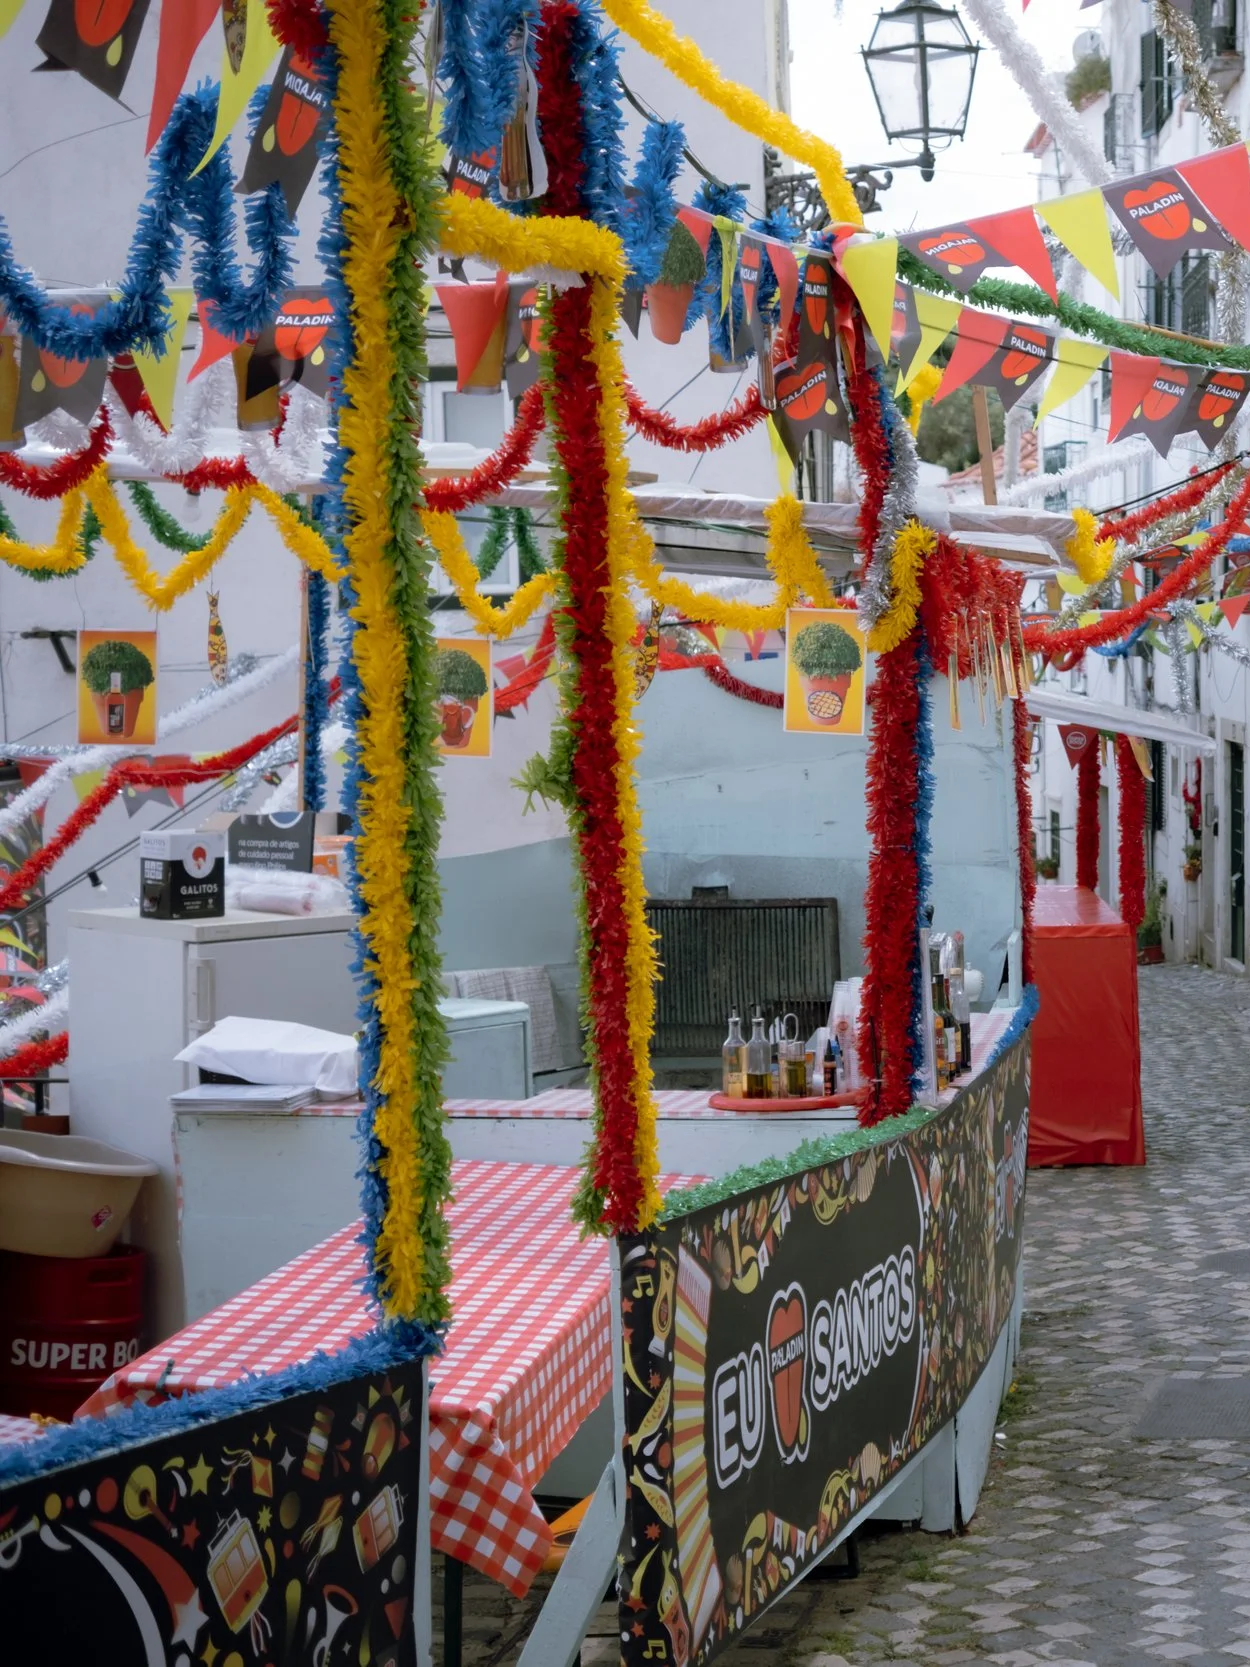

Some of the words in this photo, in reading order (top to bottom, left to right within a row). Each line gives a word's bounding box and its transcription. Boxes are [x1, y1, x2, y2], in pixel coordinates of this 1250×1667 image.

[456, 159, 490, 184] PALADIN
[1129, 193, 1184, 220] PALADIN
[804, 283, 828, 297] PALADIN
[1010, 336, 1046, 358] PALADIN
[780, 370, 827, 407] PALADIN
[1206, 383, 1241, 400] PALADIN
[247, 840, 268, 850] compra
[269, 839, 278, 848] de
[279, 838, 299, 850] artigos
[238, 850, 246, 858] de
[247, 850, 270, 859] cuidado
[271, 850, 294, 861] pessoal
[180, 884, 218, 895] GALITOS
[10, 1338, 107, 1370] SUPER
[113, 1338, 138, 1368] BO
[715, 1350, 763, 1480] EU
[772, 1334, 803, 1373] PALADIN
[812, 1252, 914, 1403] SANTOS
